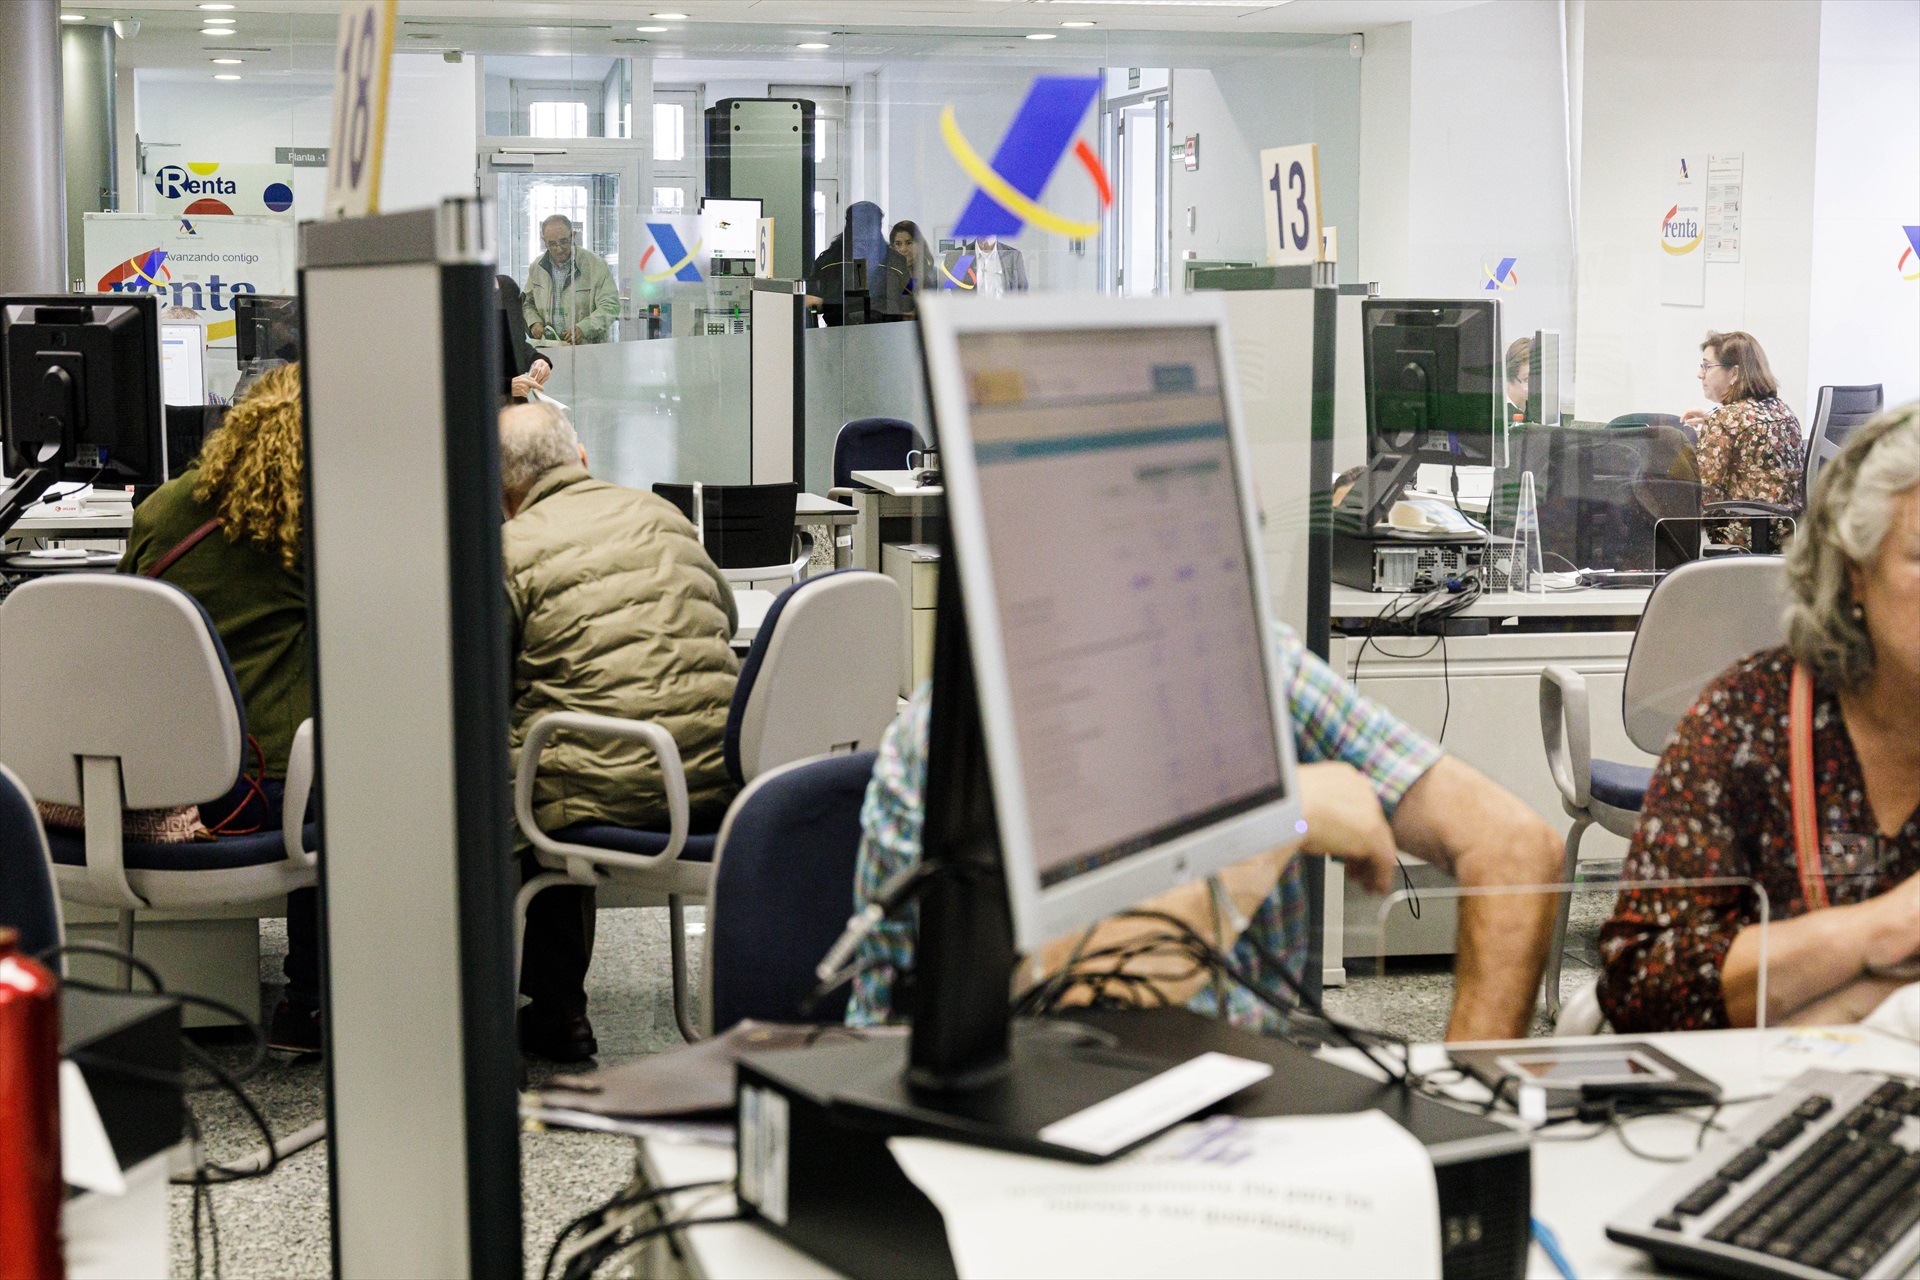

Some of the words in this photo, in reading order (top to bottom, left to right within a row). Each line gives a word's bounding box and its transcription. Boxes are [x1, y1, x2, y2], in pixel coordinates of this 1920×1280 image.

[334, 8, 374, 189] 18
[288, 152, 316, 162] Planta
[162, 168, 237, 199] Renta
[1269, 160, 1310, 251] 13
[1664, 218, 1698, 238] renta
[164, 252, 220, 262] Avanzando
[222, 252, 259, 265] contigo
[760, 226, 766, 271] 6
